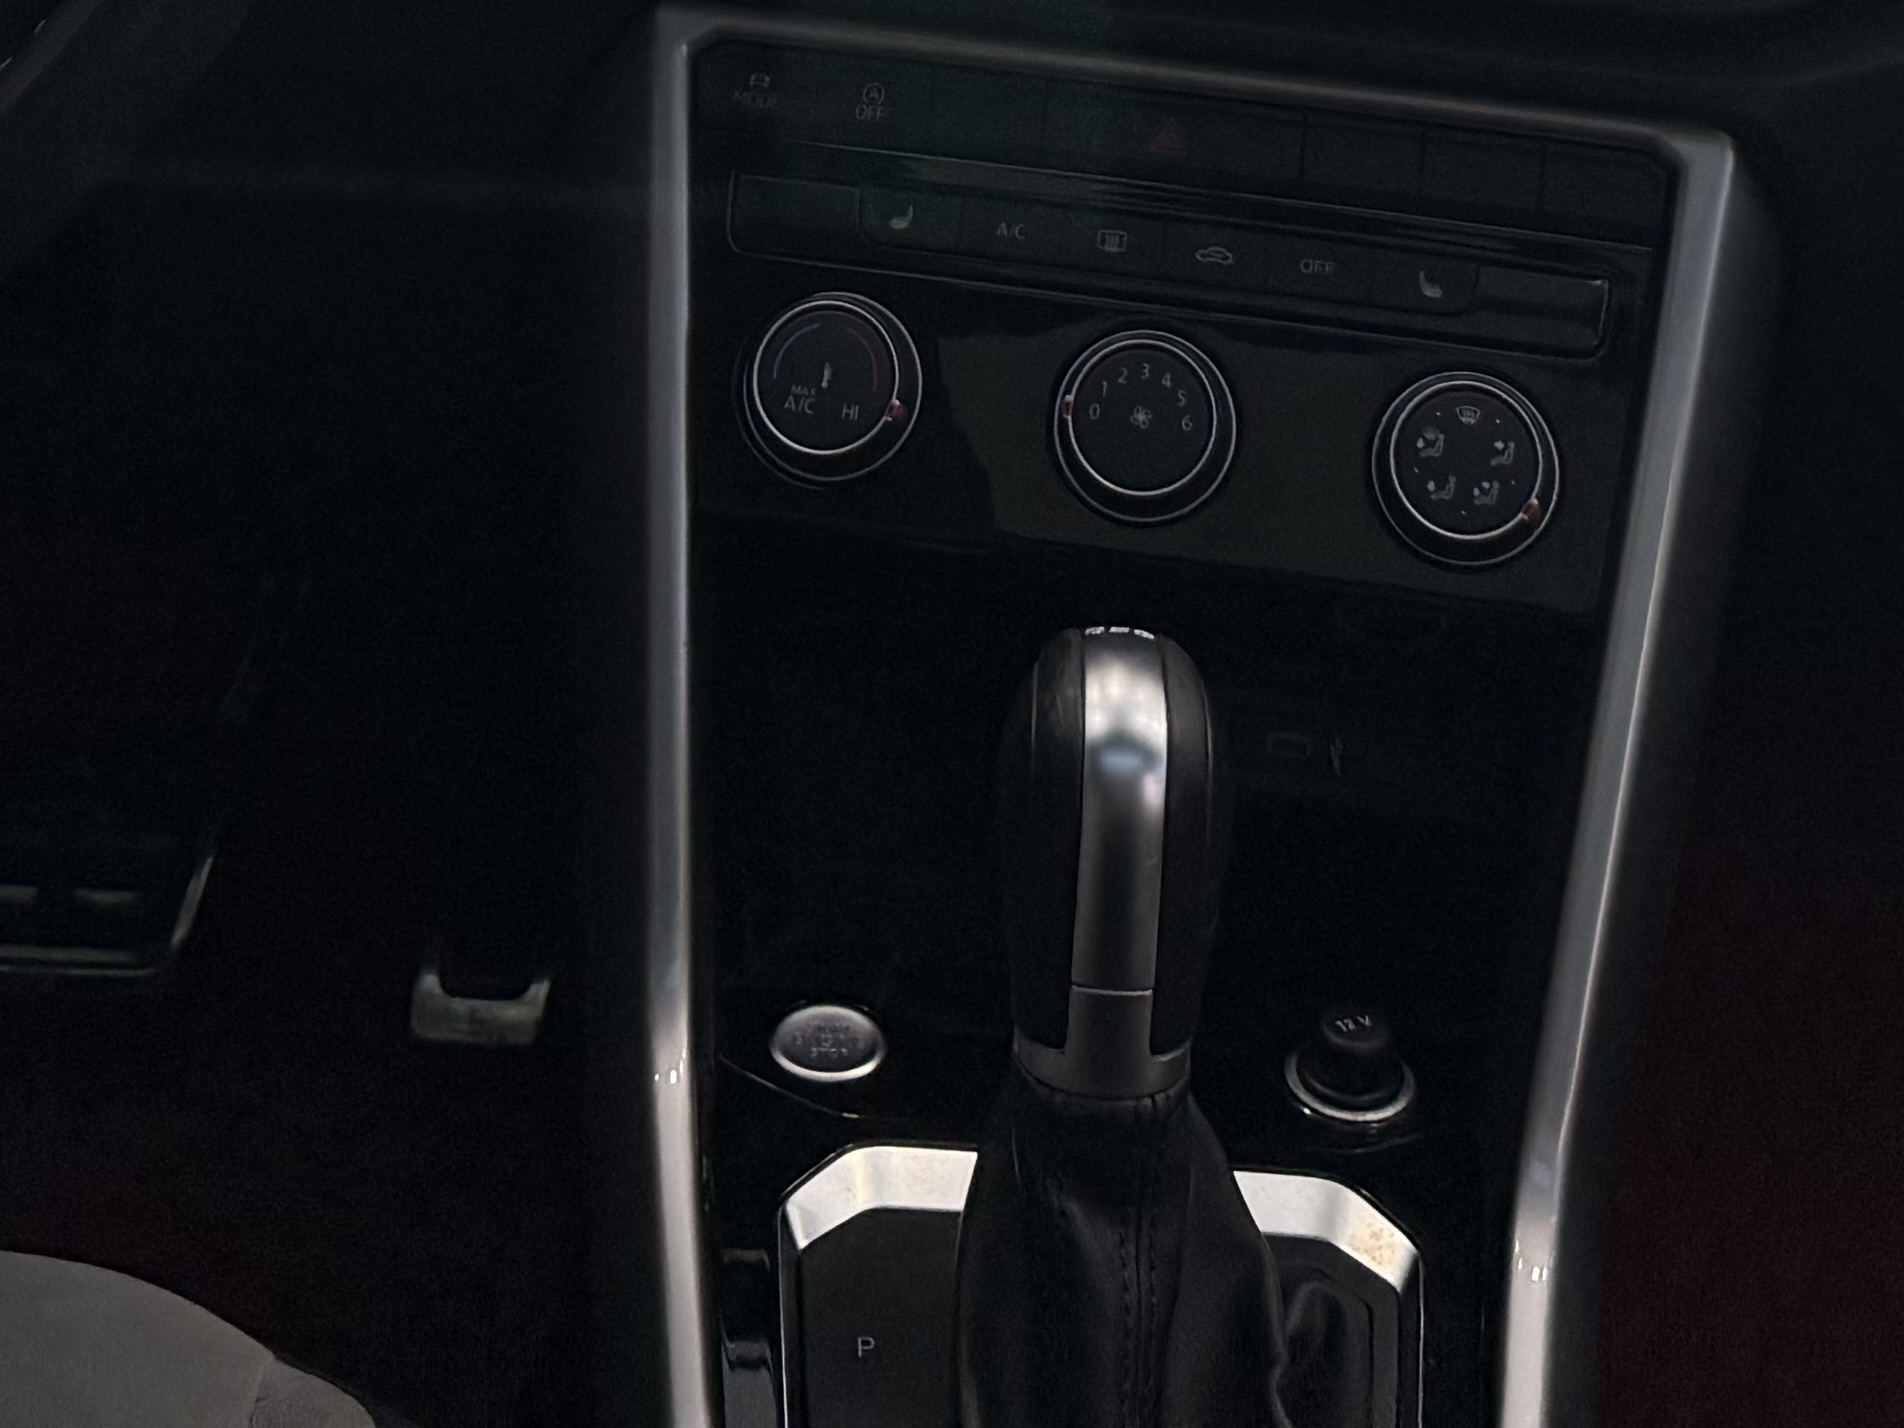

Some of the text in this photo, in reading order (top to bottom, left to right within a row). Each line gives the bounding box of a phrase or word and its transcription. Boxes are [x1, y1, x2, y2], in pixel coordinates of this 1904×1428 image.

[996, 222, 1025, 240] A/C
[1117, 367, 1129, 385] 2
[1141, 362, 1150, 381] 3
[1161, 372, 1172, 390] 4
[783, 394, 817, 415] A/C
[1177, 389, 1186, 408] 5
[841, 403, 860, 421] HI
[1181, 414, 1193, 431] 6
[857, 1336, 876, 1359] P
